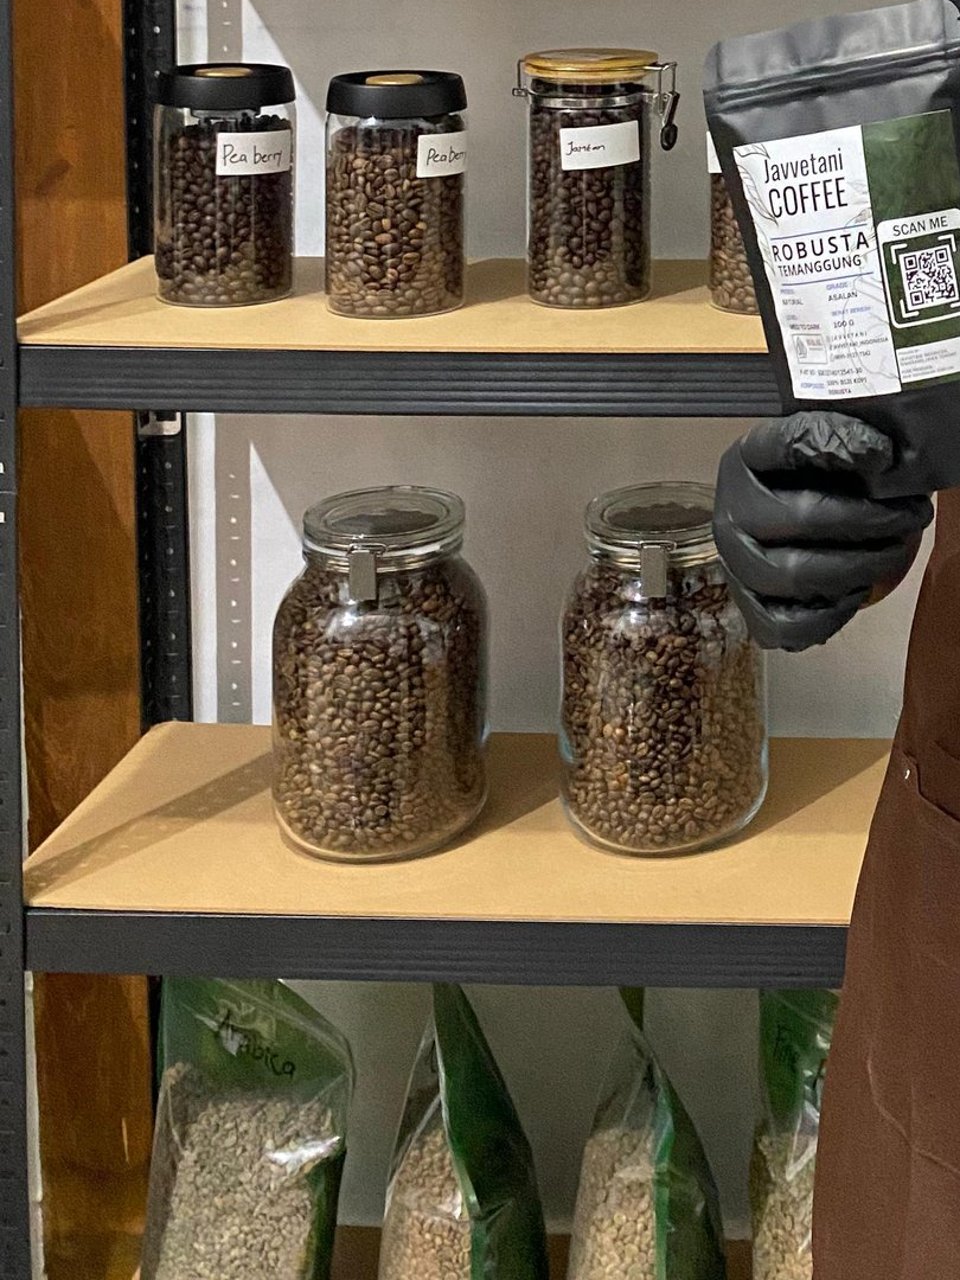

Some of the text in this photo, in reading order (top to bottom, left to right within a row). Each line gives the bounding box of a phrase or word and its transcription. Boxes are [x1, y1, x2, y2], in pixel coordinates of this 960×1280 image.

[764, 147, 844, 184] Javvetani
[768, 177, 849, 219] COFFEE
[892, 216, 949, 237] SCAN ME
[771, 231, 870, 263] ROBUSTA
[777, 254, 862, 278] TEMANGGUNG
